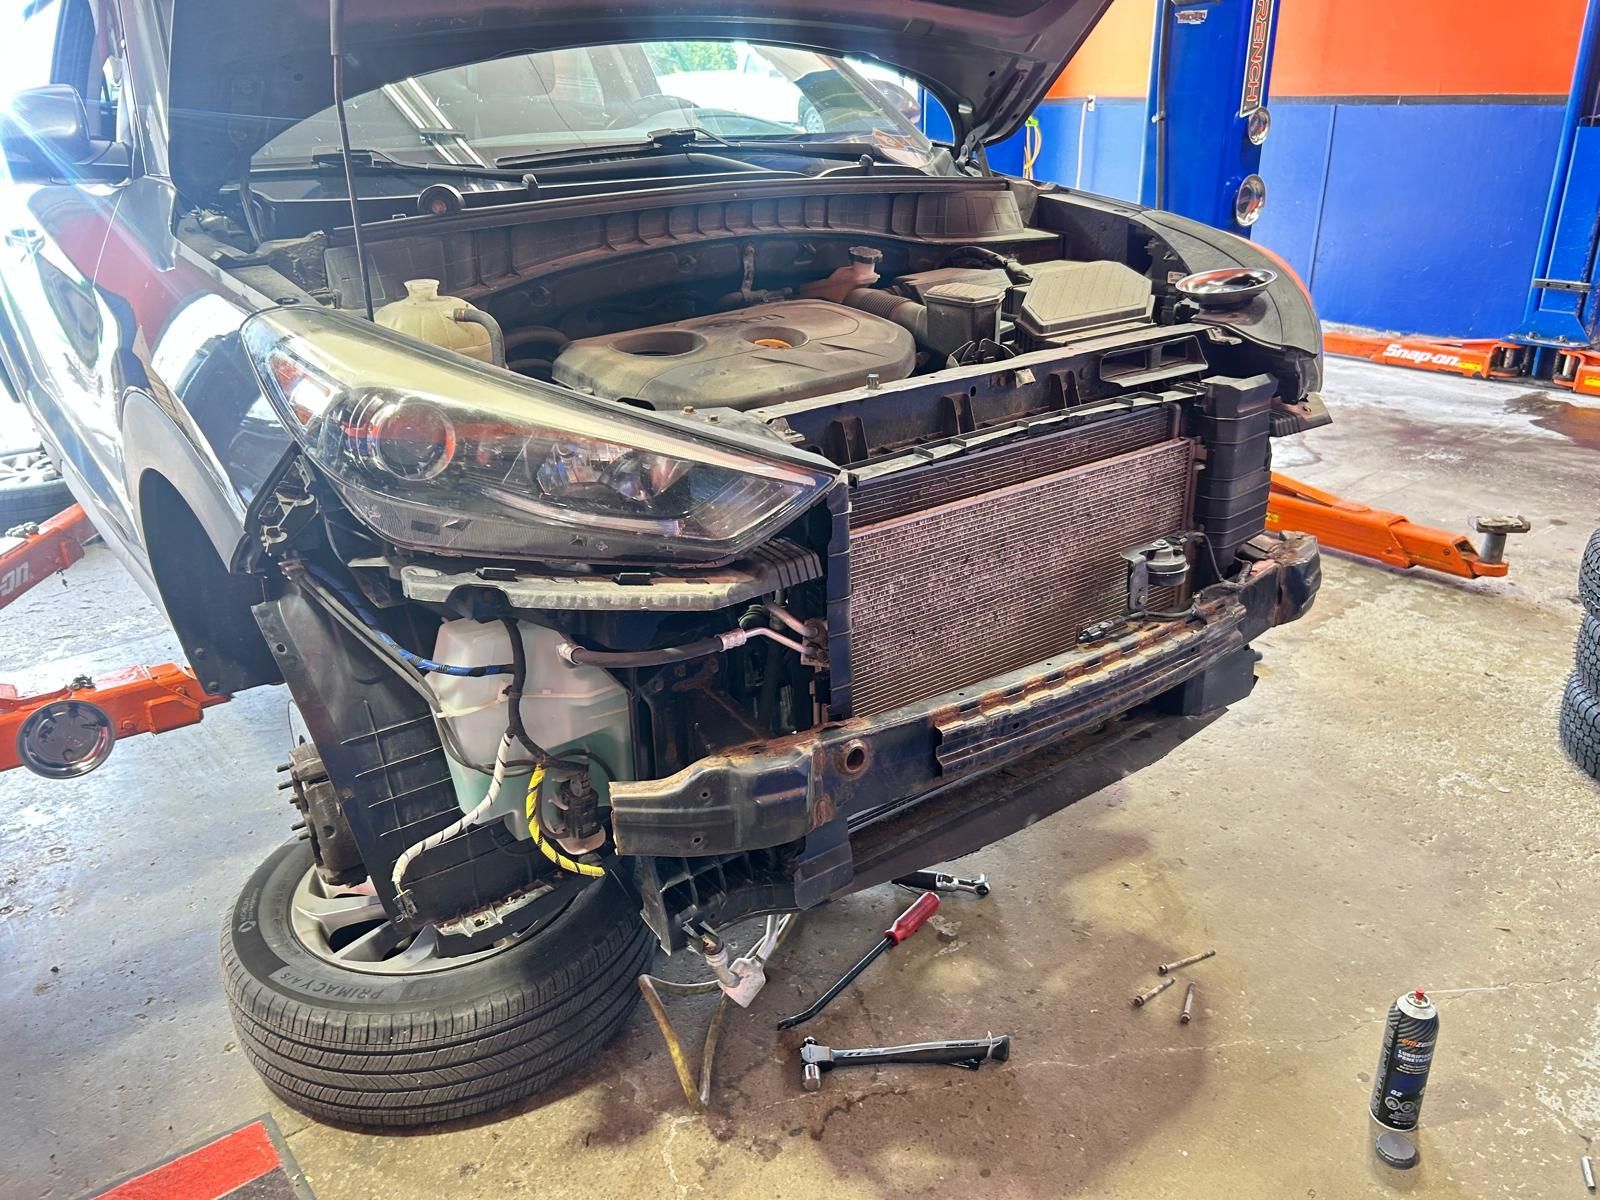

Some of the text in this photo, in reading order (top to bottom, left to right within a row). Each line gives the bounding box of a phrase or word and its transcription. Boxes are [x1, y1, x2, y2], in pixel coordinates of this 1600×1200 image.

[1382, 343, 1460, 367] Snap-on
[279, 972, 384, 1000] PRIMACY A/S
